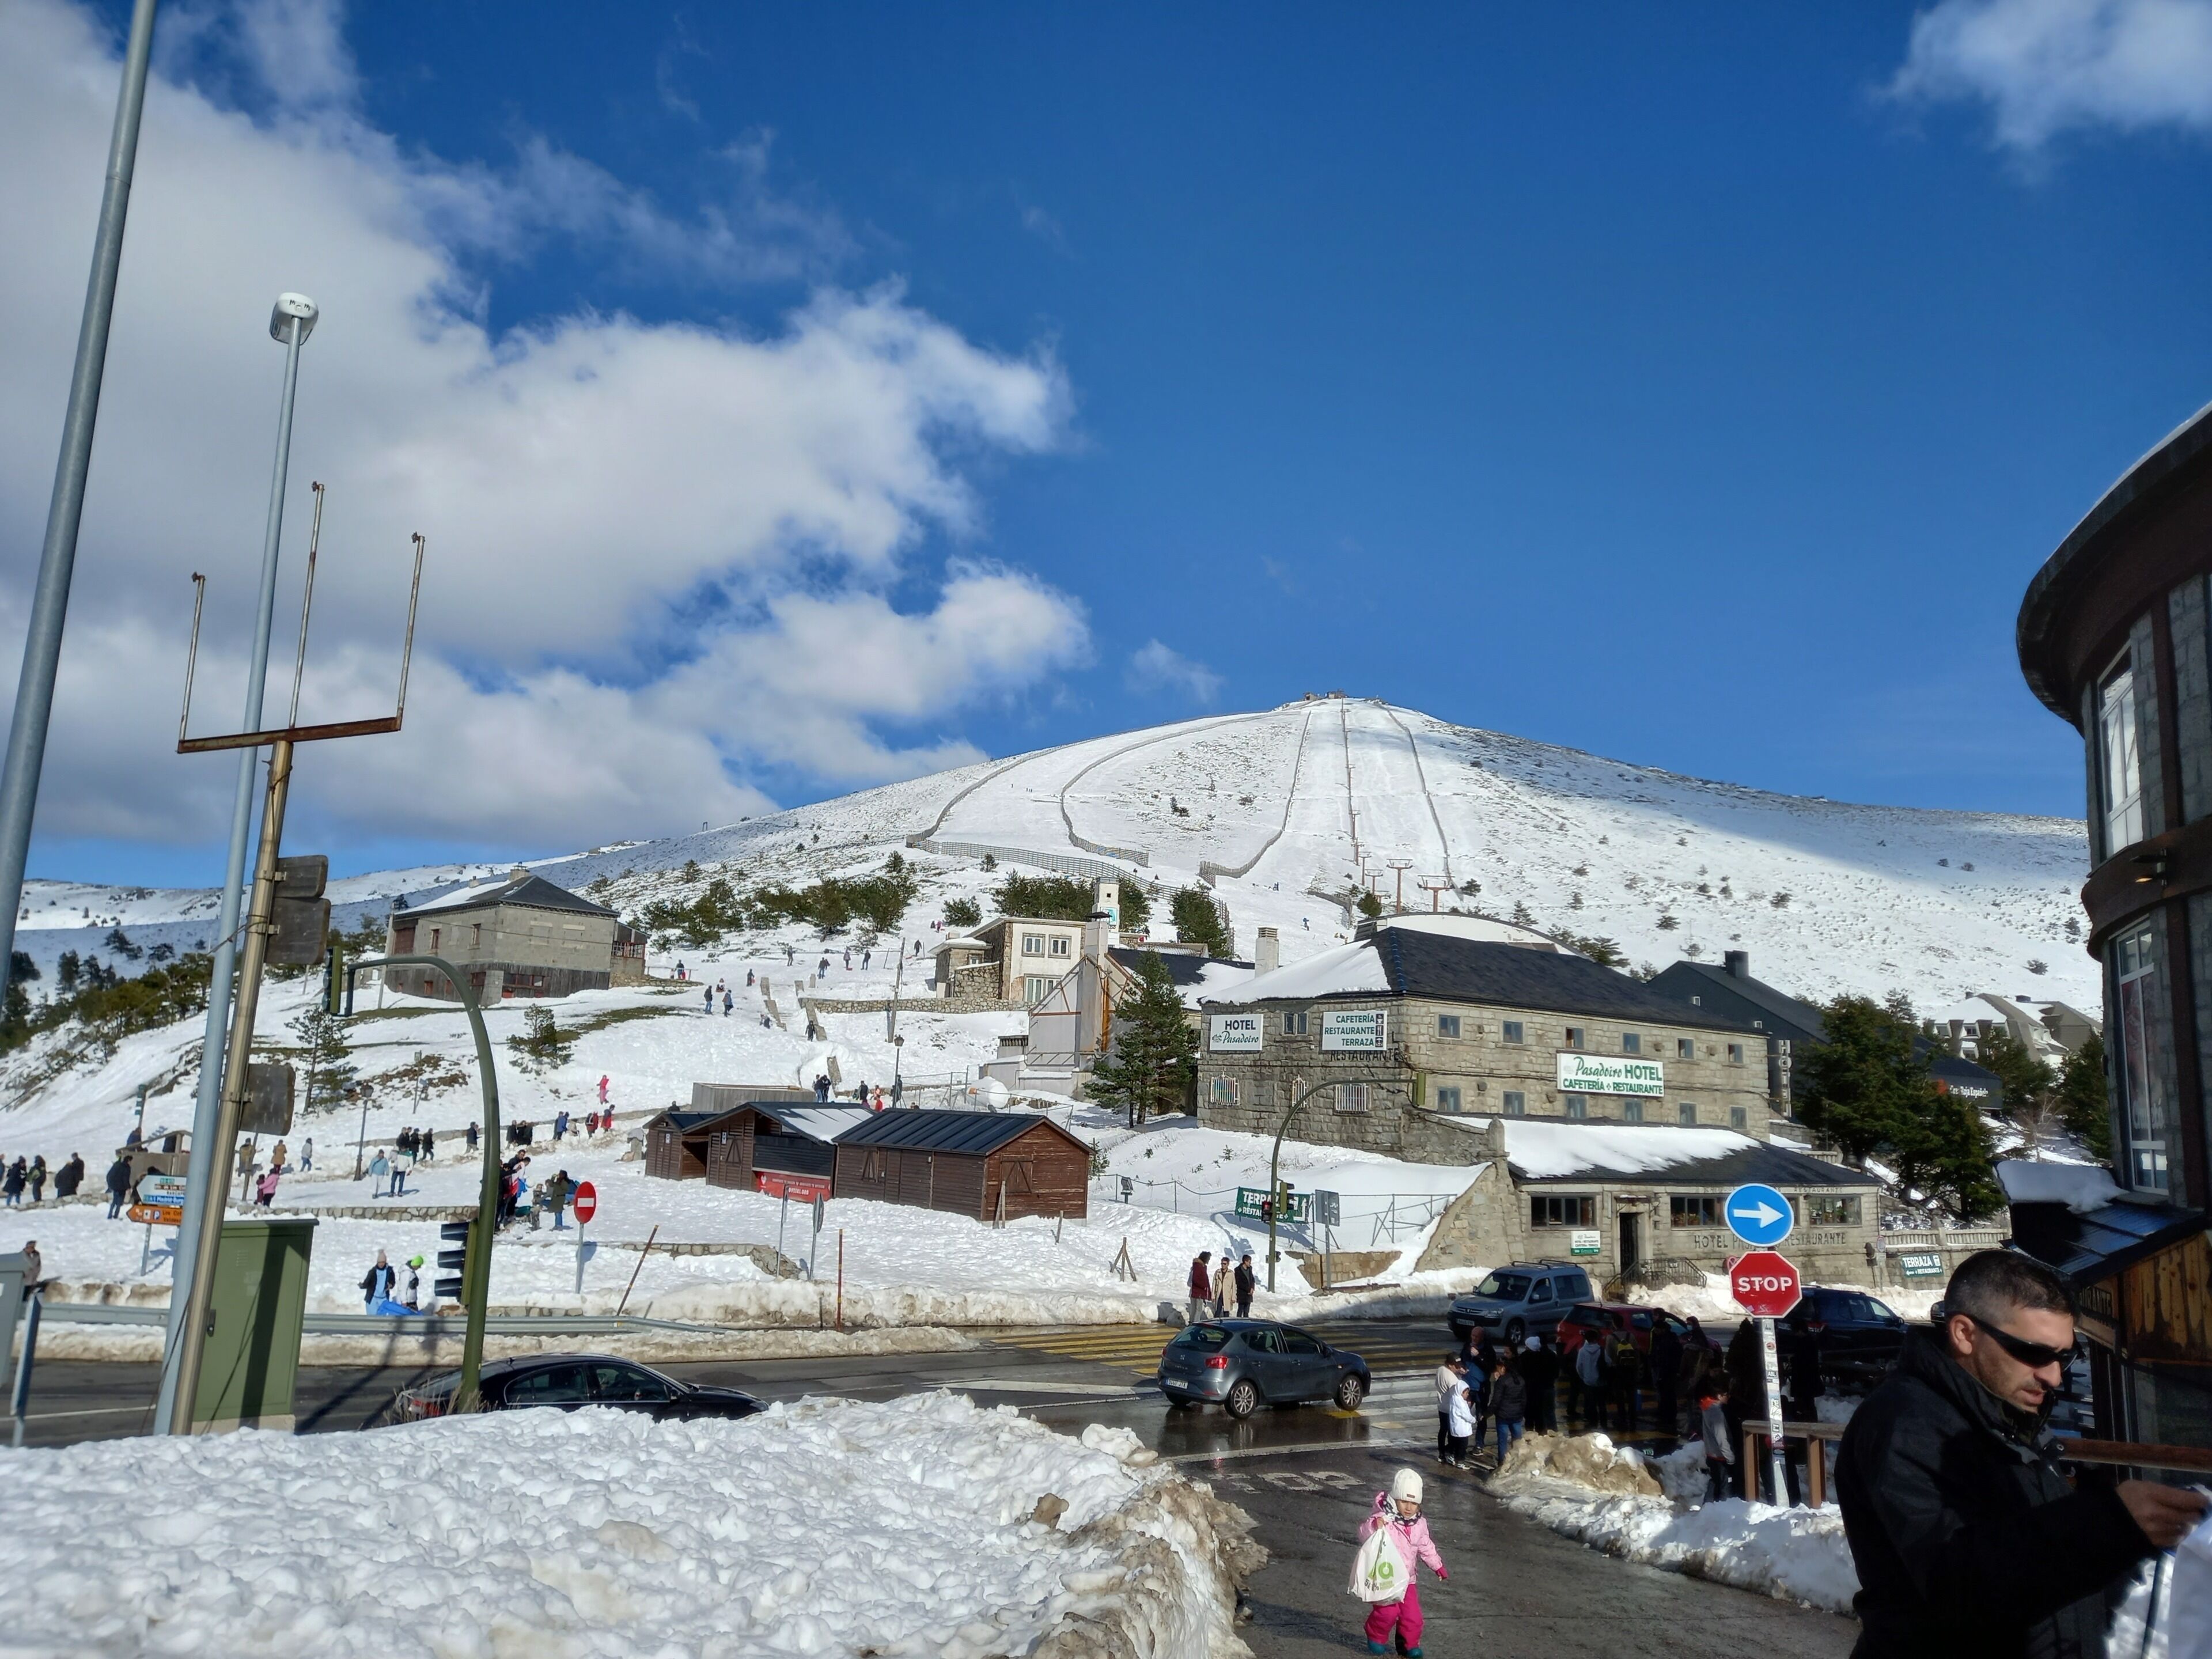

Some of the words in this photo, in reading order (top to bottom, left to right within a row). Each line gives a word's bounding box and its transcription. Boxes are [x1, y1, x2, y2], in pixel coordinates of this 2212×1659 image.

[1336, 1013, 1375, 1023] CAFETERÍA
[1225, 1020, 1256, 1030] HOTEL
[1324, 1027, 1374, 1035] RESTAURANTE
[1221, 1031, 1259, 1044] Pasadoiro
[1342, 1038, 1374, 1046] TERRAZA
[1573, 1056, 1622, 1077] Pasadoiro
[1624, 1065, 1662, 1081] HOTEL
[1563, 1078, 1605, 1090] CAFETERÍA
[1613, 1082, 1663, 1094] RESTAURANTE
[1694, 1235, 1728, 1248] HOTEL
[1902, 1256, 1933, 1268] TERRAZA
[1738, 1277, 1793, 1291] STOP
